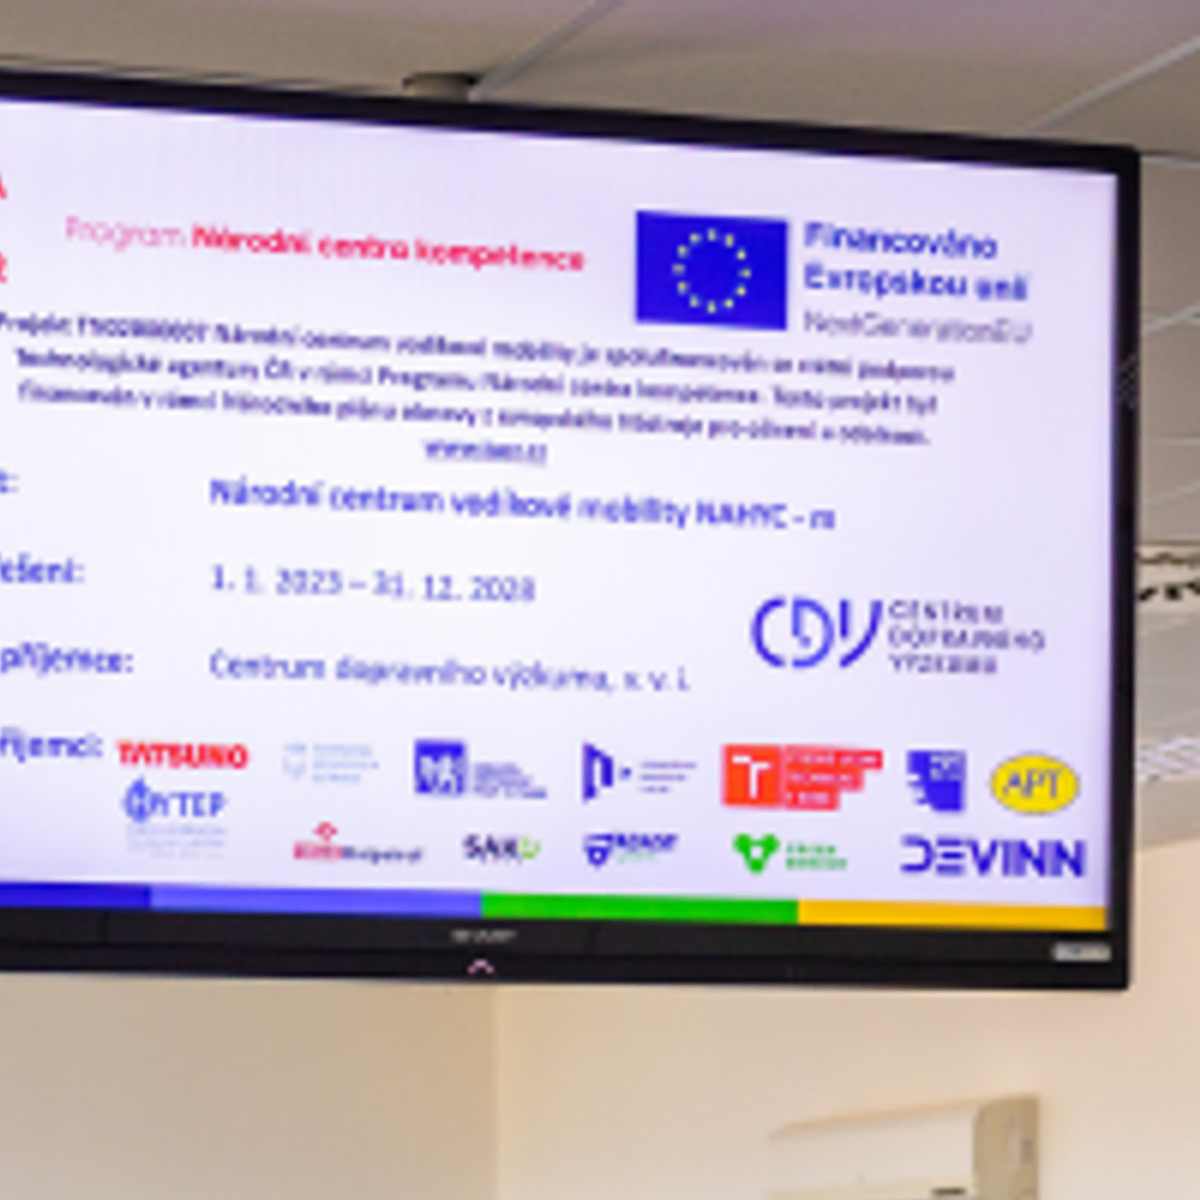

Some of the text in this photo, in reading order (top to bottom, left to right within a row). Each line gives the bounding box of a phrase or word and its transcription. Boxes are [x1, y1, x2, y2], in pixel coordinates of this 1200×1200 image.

[66, 216, 187, 252] Program
[416, 239, 586, 272] kompetence
[329, 487, 444, 513] centrum
[578, 495, 689, 529] mobility
[116, 739, 248, 769] TATSUNO
[1001, 770, 1064, 801] APT
[900, 834, 1087, 878] DEVINN
